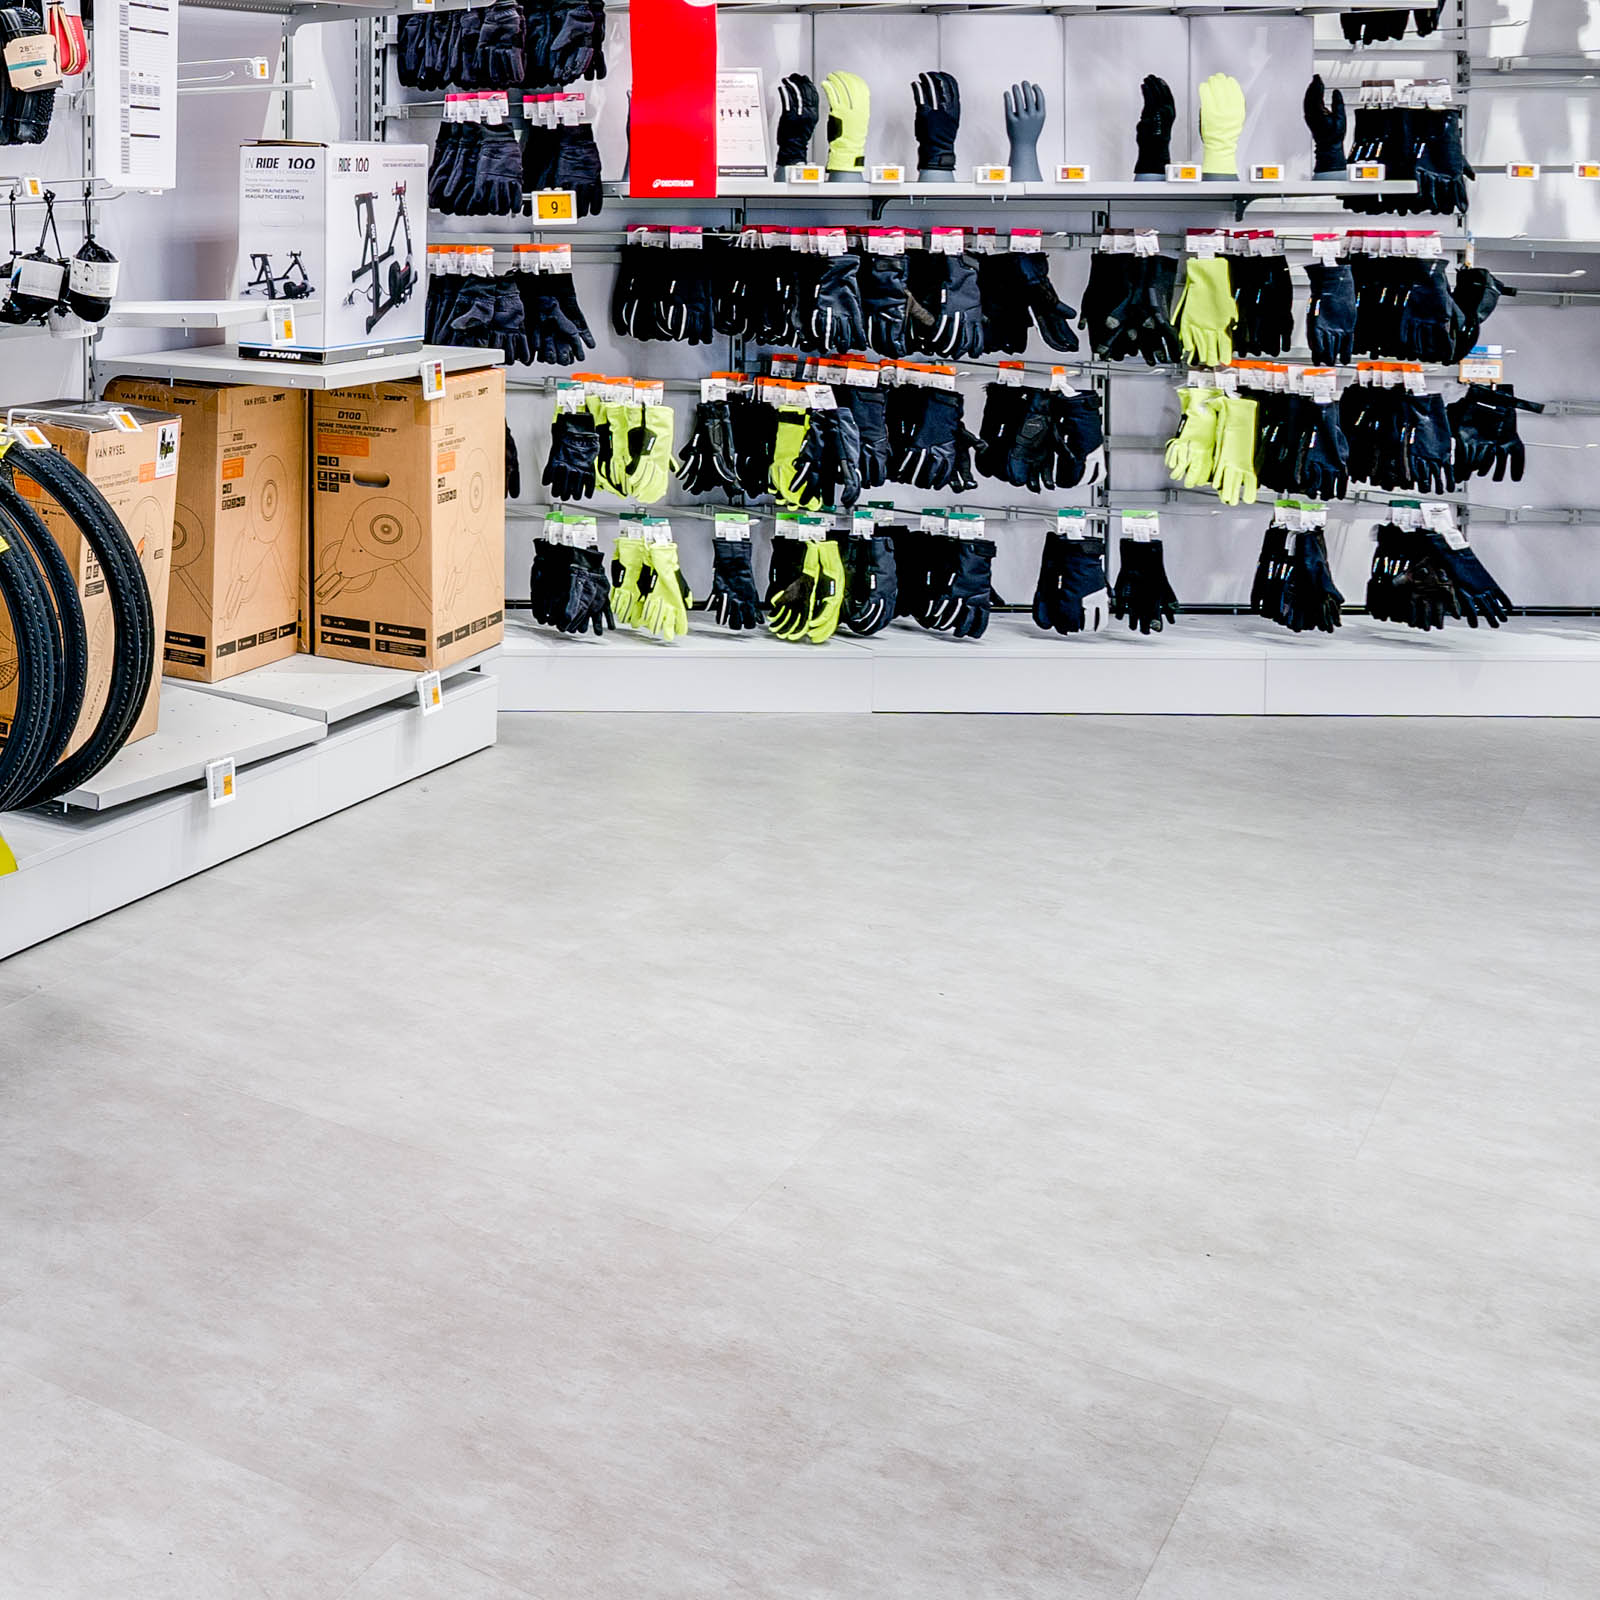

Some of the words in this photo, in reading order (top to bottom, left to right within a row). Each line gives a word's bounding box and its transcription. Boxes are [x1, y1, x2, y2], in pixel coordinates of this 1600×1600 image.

[256, 157, 279, 169] RIDE
[287, 157, 316, 170] 100
[338, 157, 351, 172] RIDE
[355, 157, 369, 172] 100
[550, 201, 559, 215] 9
[120, 392, 137, 400] VAN
[137, 394, 161, 403] RYSEL
[329, 390, 347, 399] VAN
[347, 391, 372, 400] RYSEL
[337, 410, 361, 421] D100
[317, 428, 355, 436] INTERACTIVE
[355, 430, 381, 438] TRAINER
[335, 423, 361, 431] TRAINER
[361, 424, 398, 433] INTERACTIF
[95, 447, 108, 459] VAN
[108, 444, 126, 457] RYSEL
